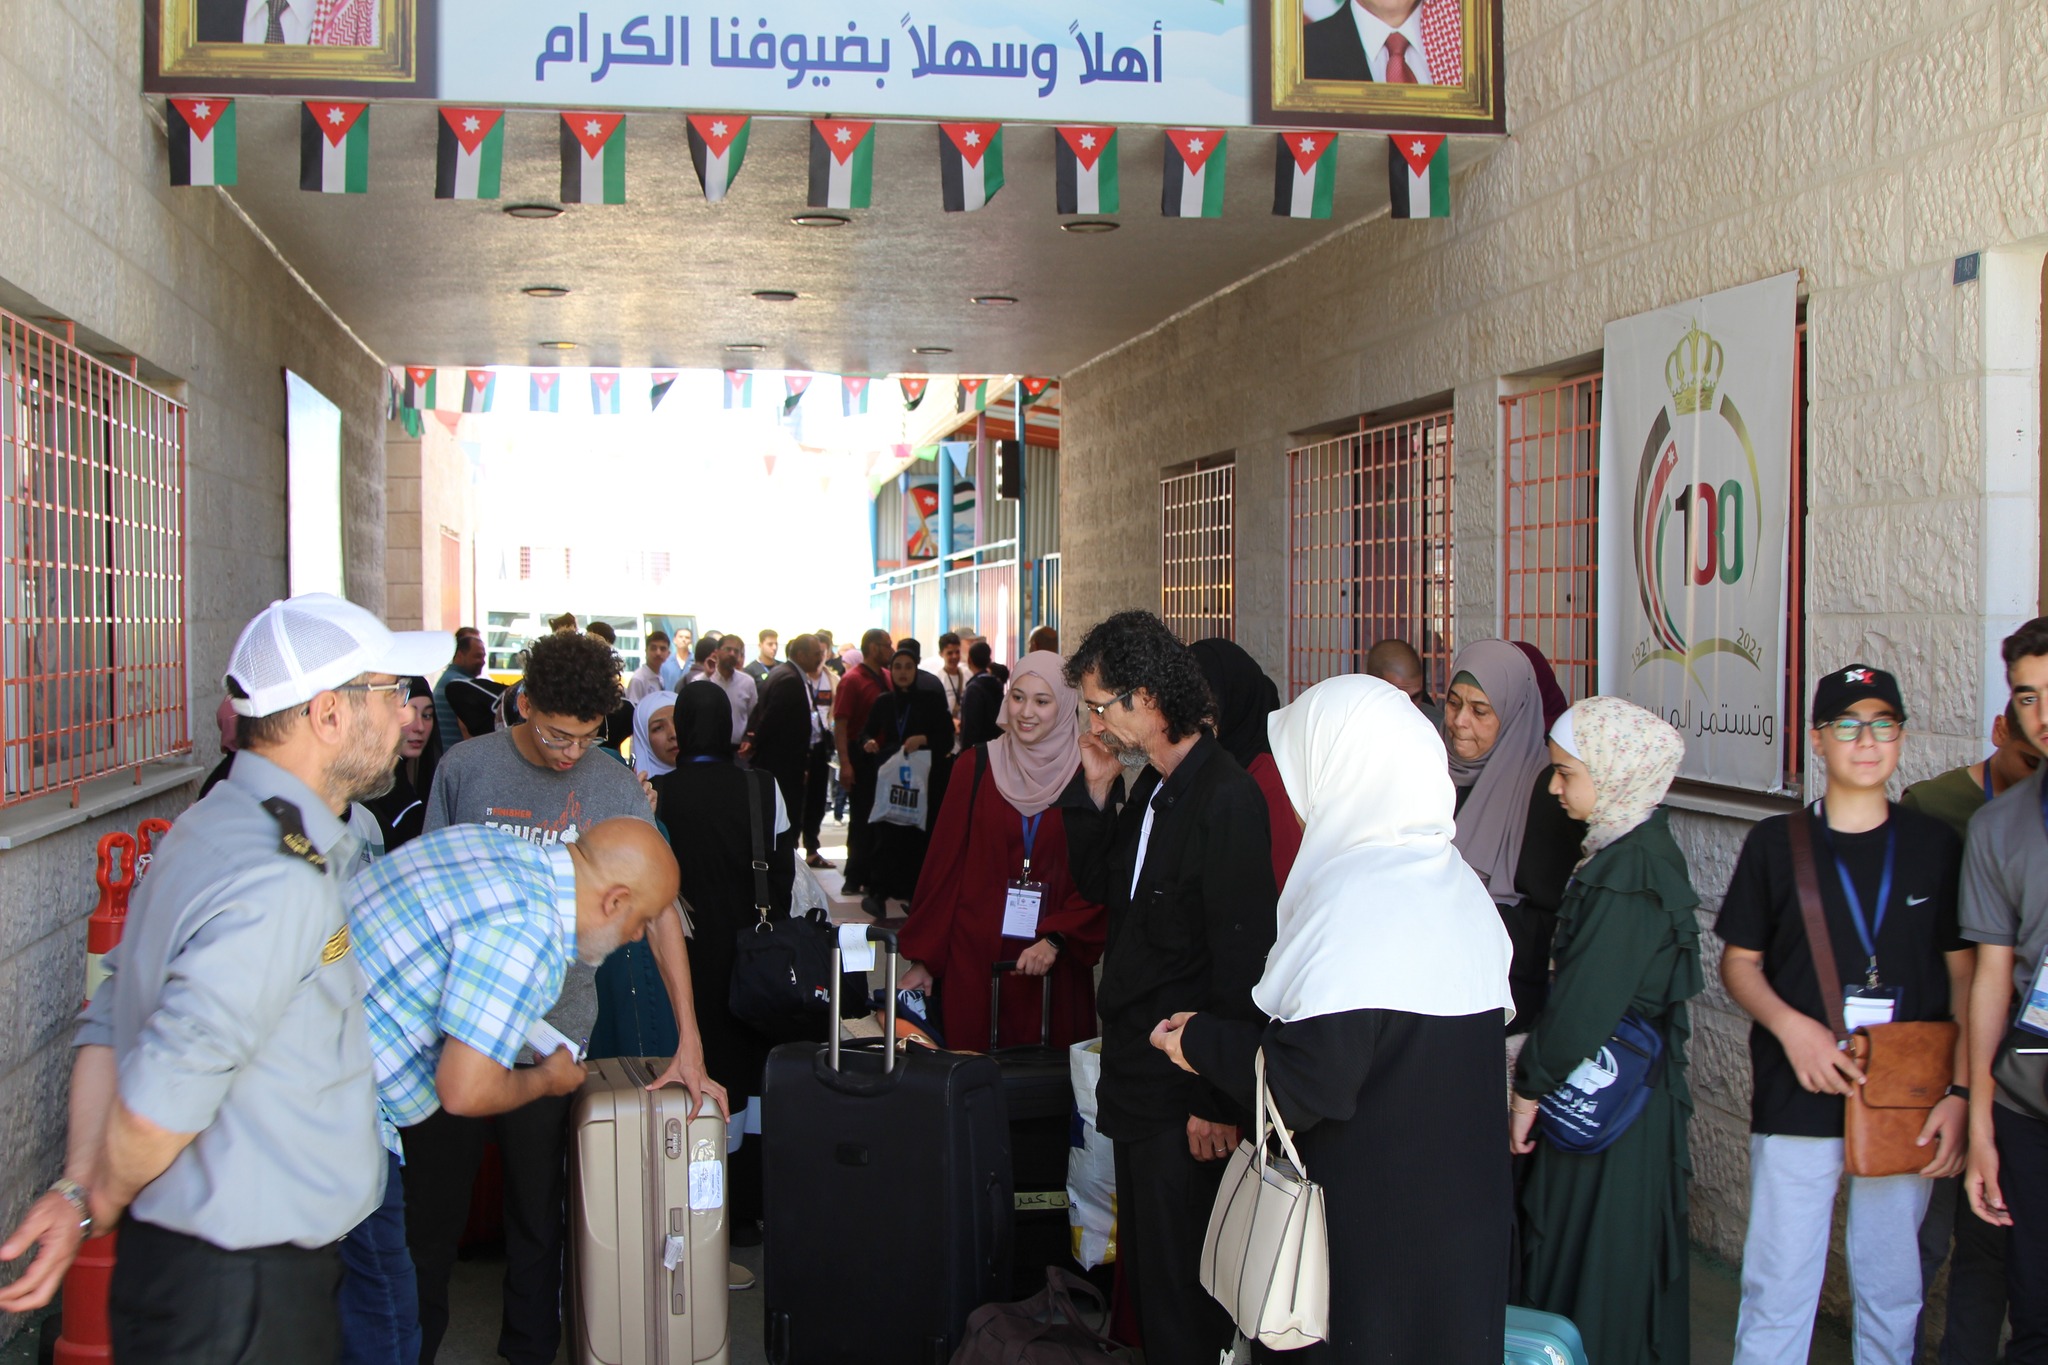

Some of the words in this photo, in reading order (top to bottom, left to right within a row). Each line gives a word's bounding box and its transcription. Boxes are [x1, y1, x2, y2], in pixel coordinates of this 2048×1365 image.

[535, 12, 689, 83] الكرام
[710, 16, 890, 89] بضيوفنا
[1675, 478, 1744, 586] 100
[1631, 636, 1651, 667] 1921
[1736, 627, 1762, 663] 2021
[1695, 703, 1774, 746] وتستمر
[814, 985, 831, 1003] FIL
